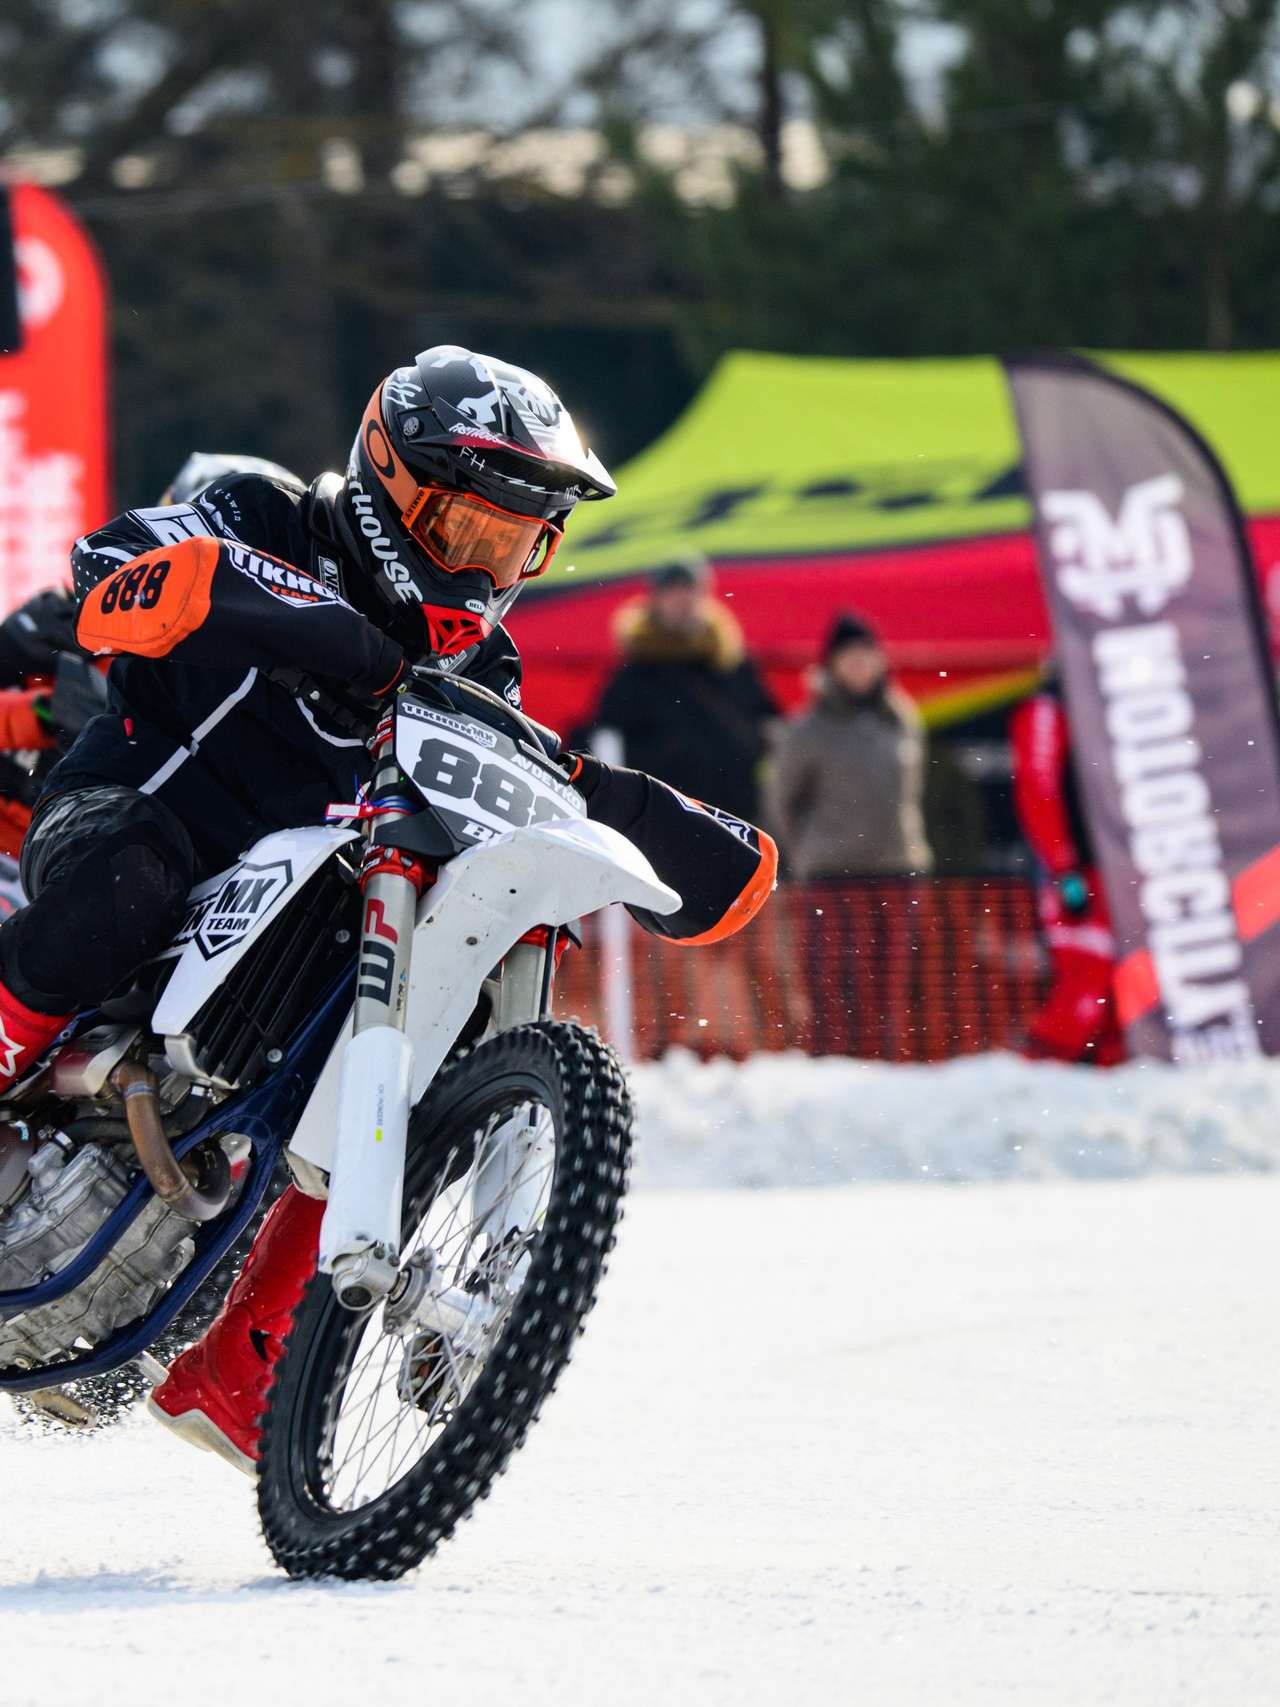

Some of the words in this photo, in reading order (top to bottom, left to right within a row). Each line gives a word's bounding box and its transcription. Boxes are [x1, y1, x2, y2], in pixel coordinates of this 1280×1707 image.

[405, 490, 425, 520] OAKLEY
[101, 560, 172, 615] 888
[270, 584, 320, 602] TEAM
[468, 601, 484, 611] BELL
[510, 752, 582, 811] AVDEYKO
[213, 878, 279, 914] MX
[206, 917, 251, 931] TEAM
[358, 898, 399, 1007] WP
